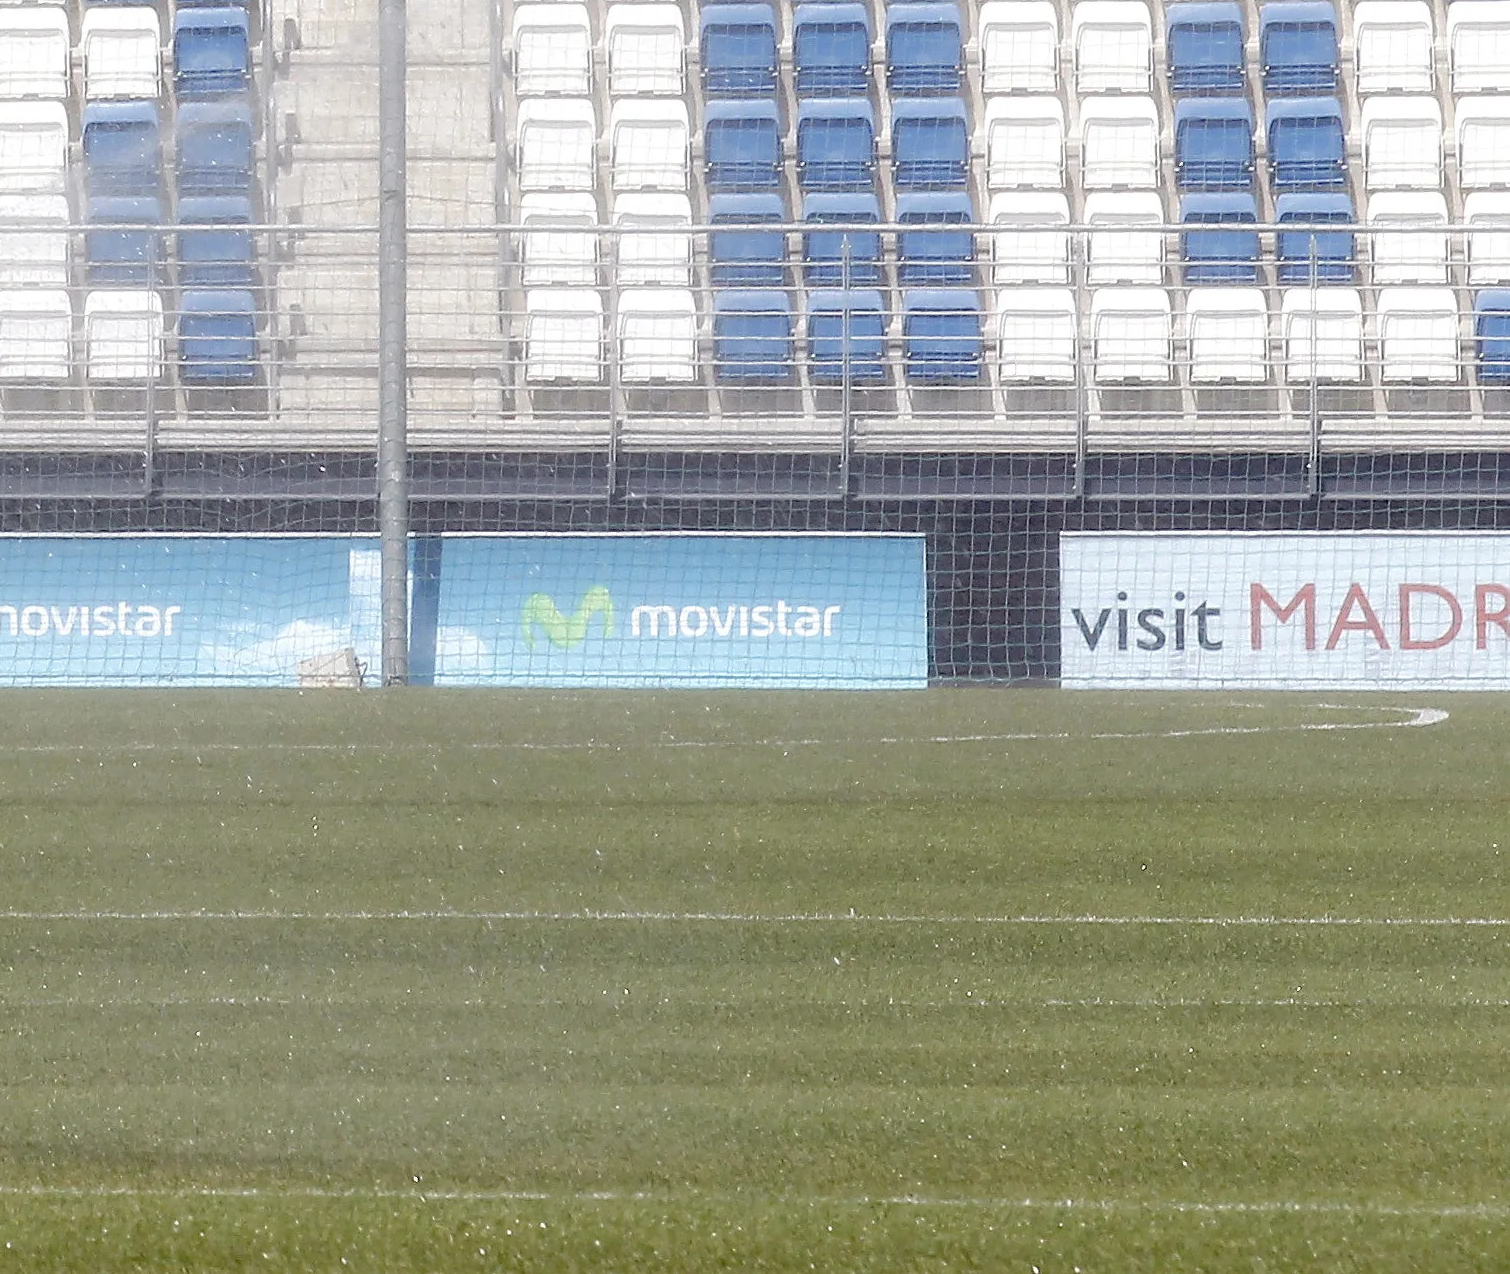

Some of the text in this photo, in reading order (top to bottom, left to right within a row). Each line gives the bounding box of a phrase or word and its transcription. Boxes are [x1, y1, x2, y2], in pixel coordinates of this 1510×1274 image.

[631, 600, 840, 637] movistar
[1072, 582, 1510, 651] visit MADR
